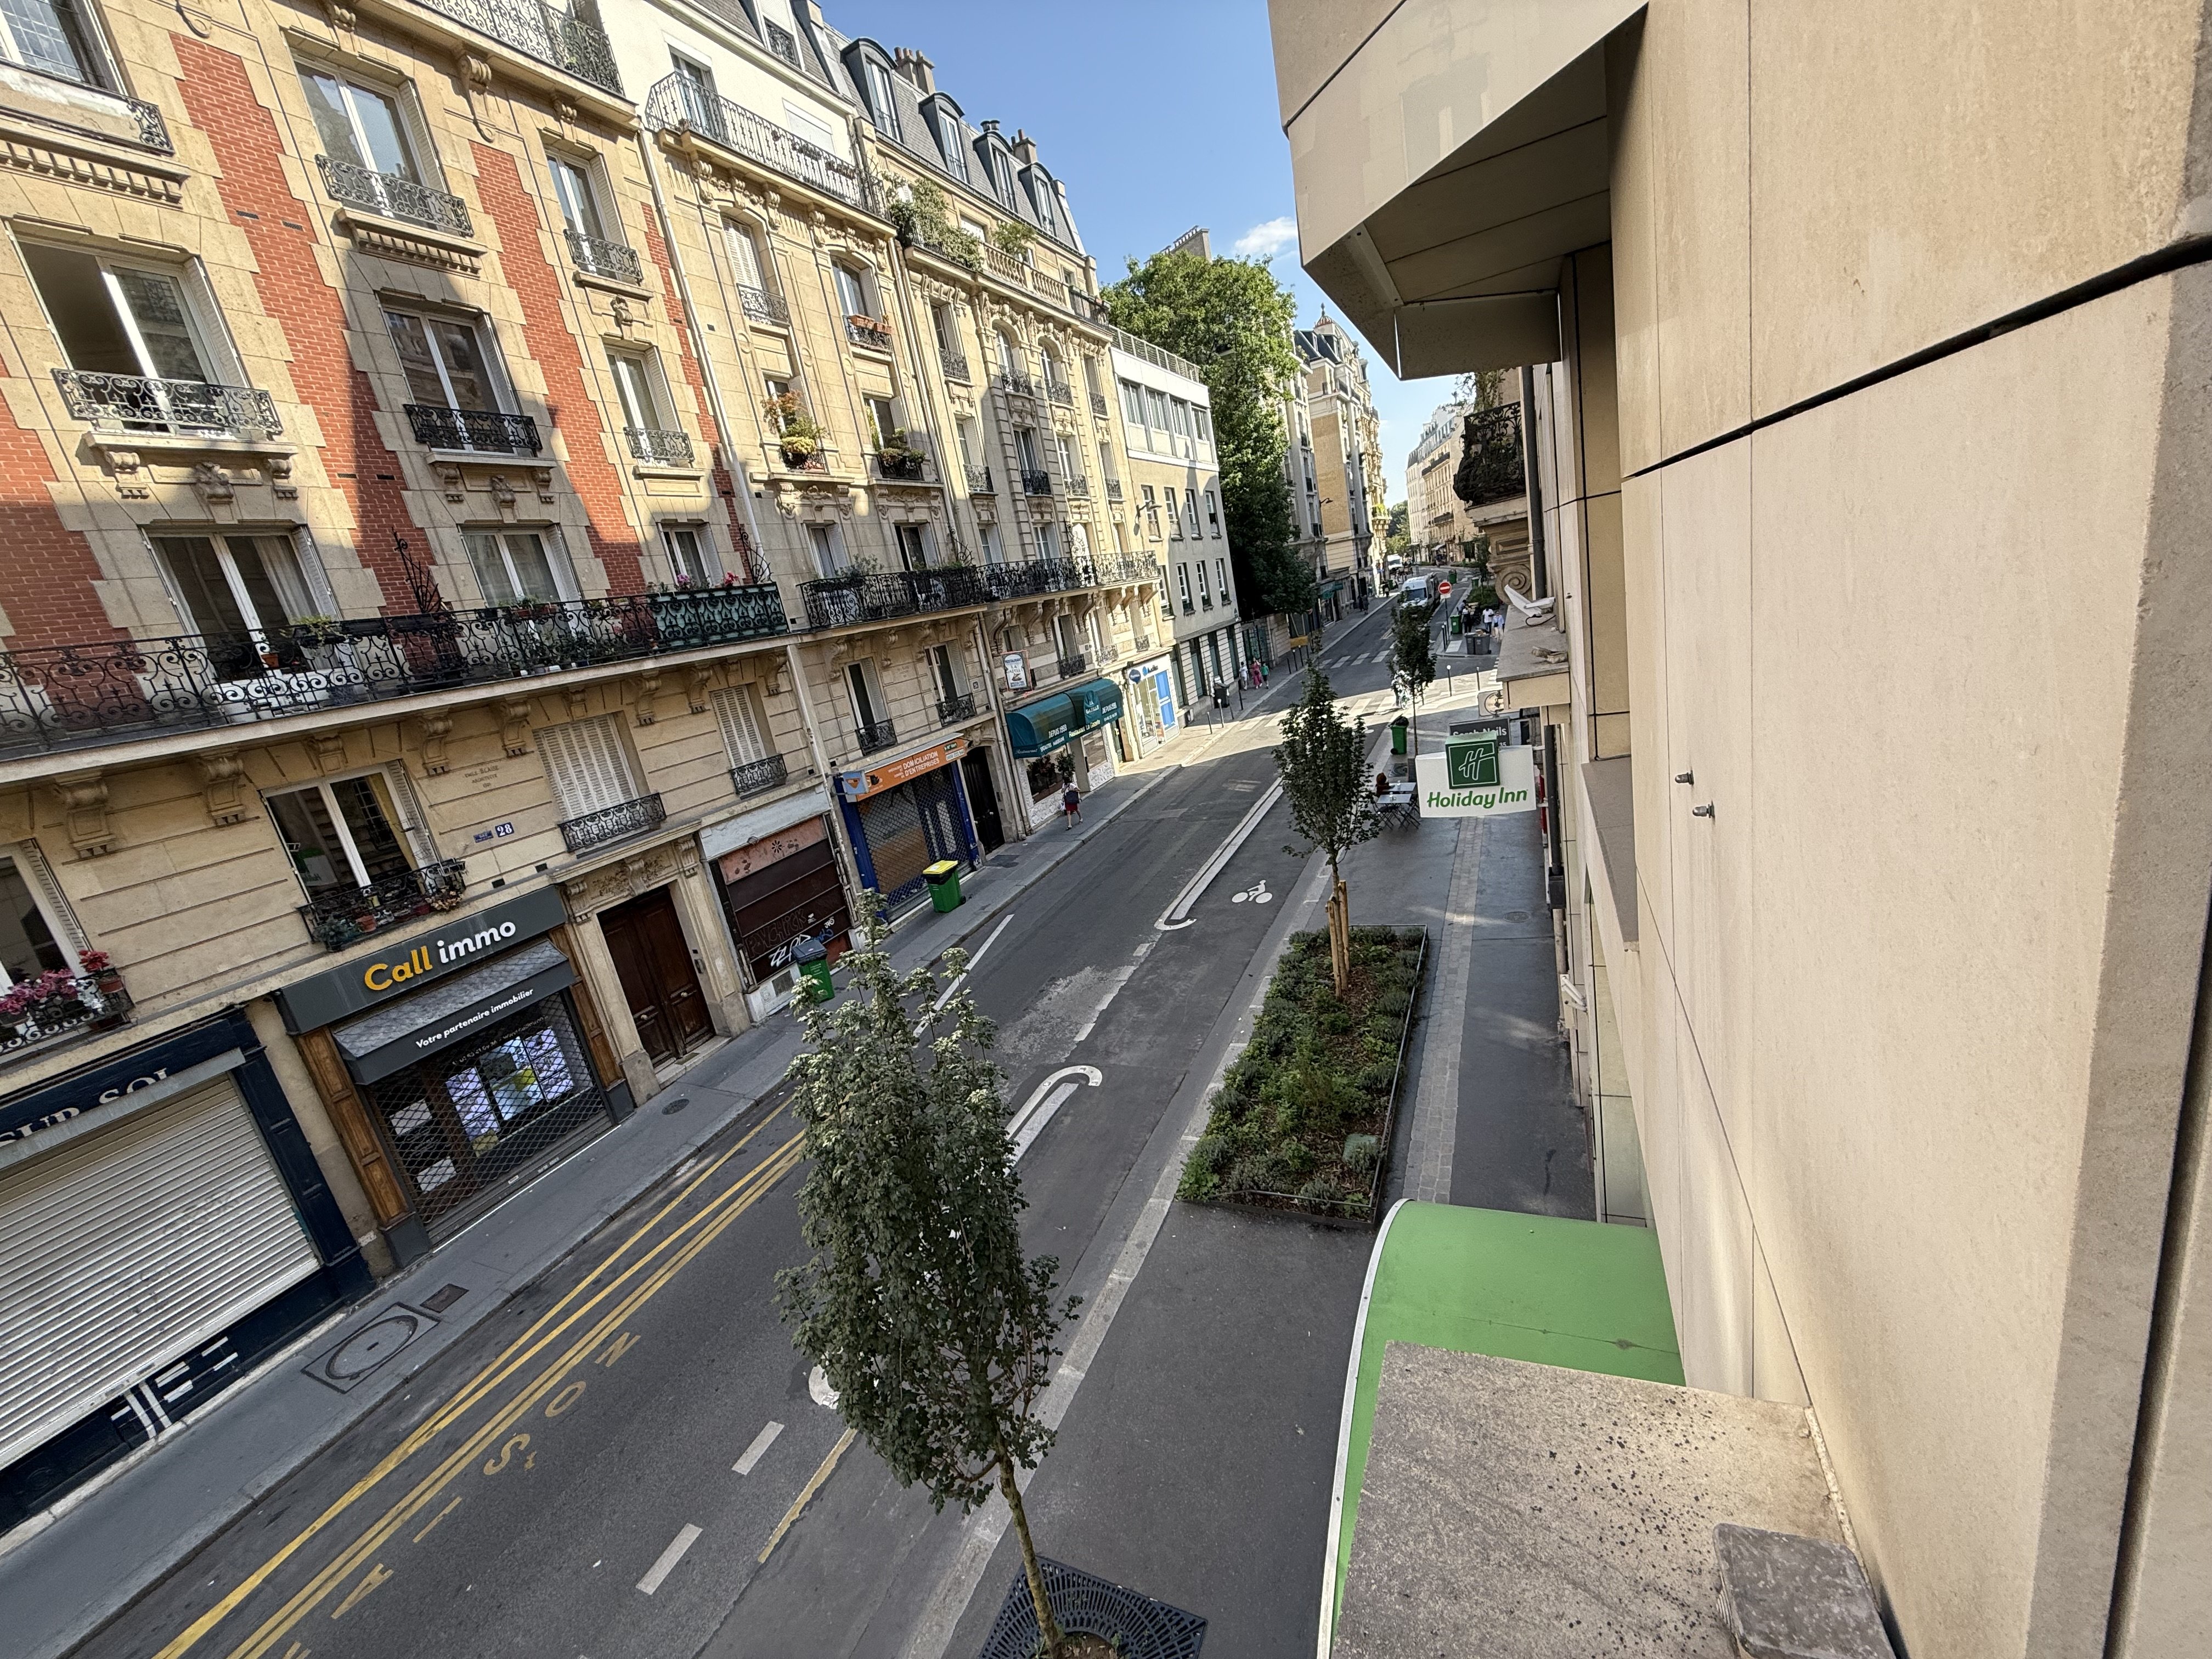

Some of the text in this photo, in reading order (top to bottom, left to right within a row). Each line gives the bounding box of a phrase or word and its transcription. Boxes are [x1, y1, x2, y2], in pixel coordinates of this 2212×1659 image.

[902, 751, 938, 770] DOMICILIATION
[905, 758, 940, 776] D'ENTREPRISES
[1427, 787, 1527, 809] Holiday Inn
[496, 824, 512, 837] 28
[364, 922, 516, 991] Call immo
[415, 988, 534, 1048] Votre partenaire immobilier
